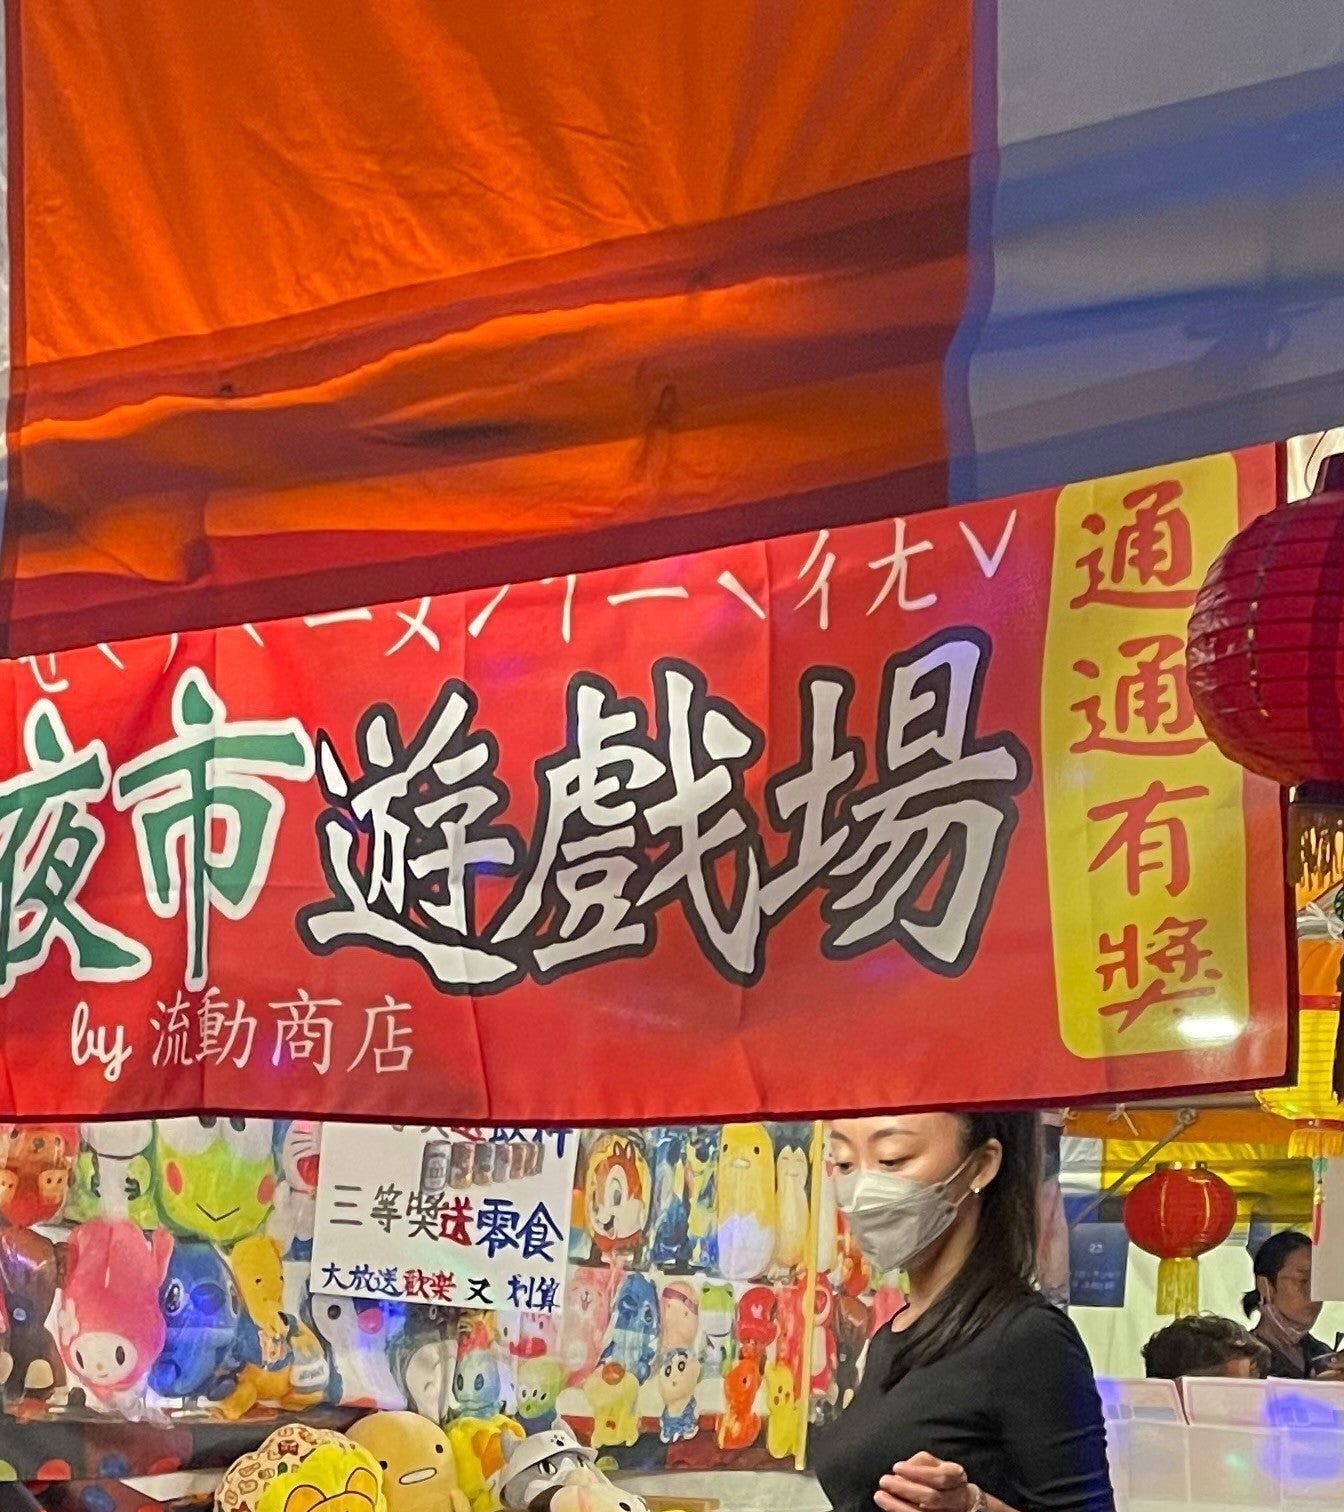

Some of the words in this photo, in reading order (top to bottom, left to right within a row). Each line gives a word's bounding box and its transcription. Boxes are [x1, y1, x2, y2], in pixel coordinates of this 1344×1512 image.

[69, 1000, 134, 1083] by
[148, 985, 415, 1076] 流動商店
